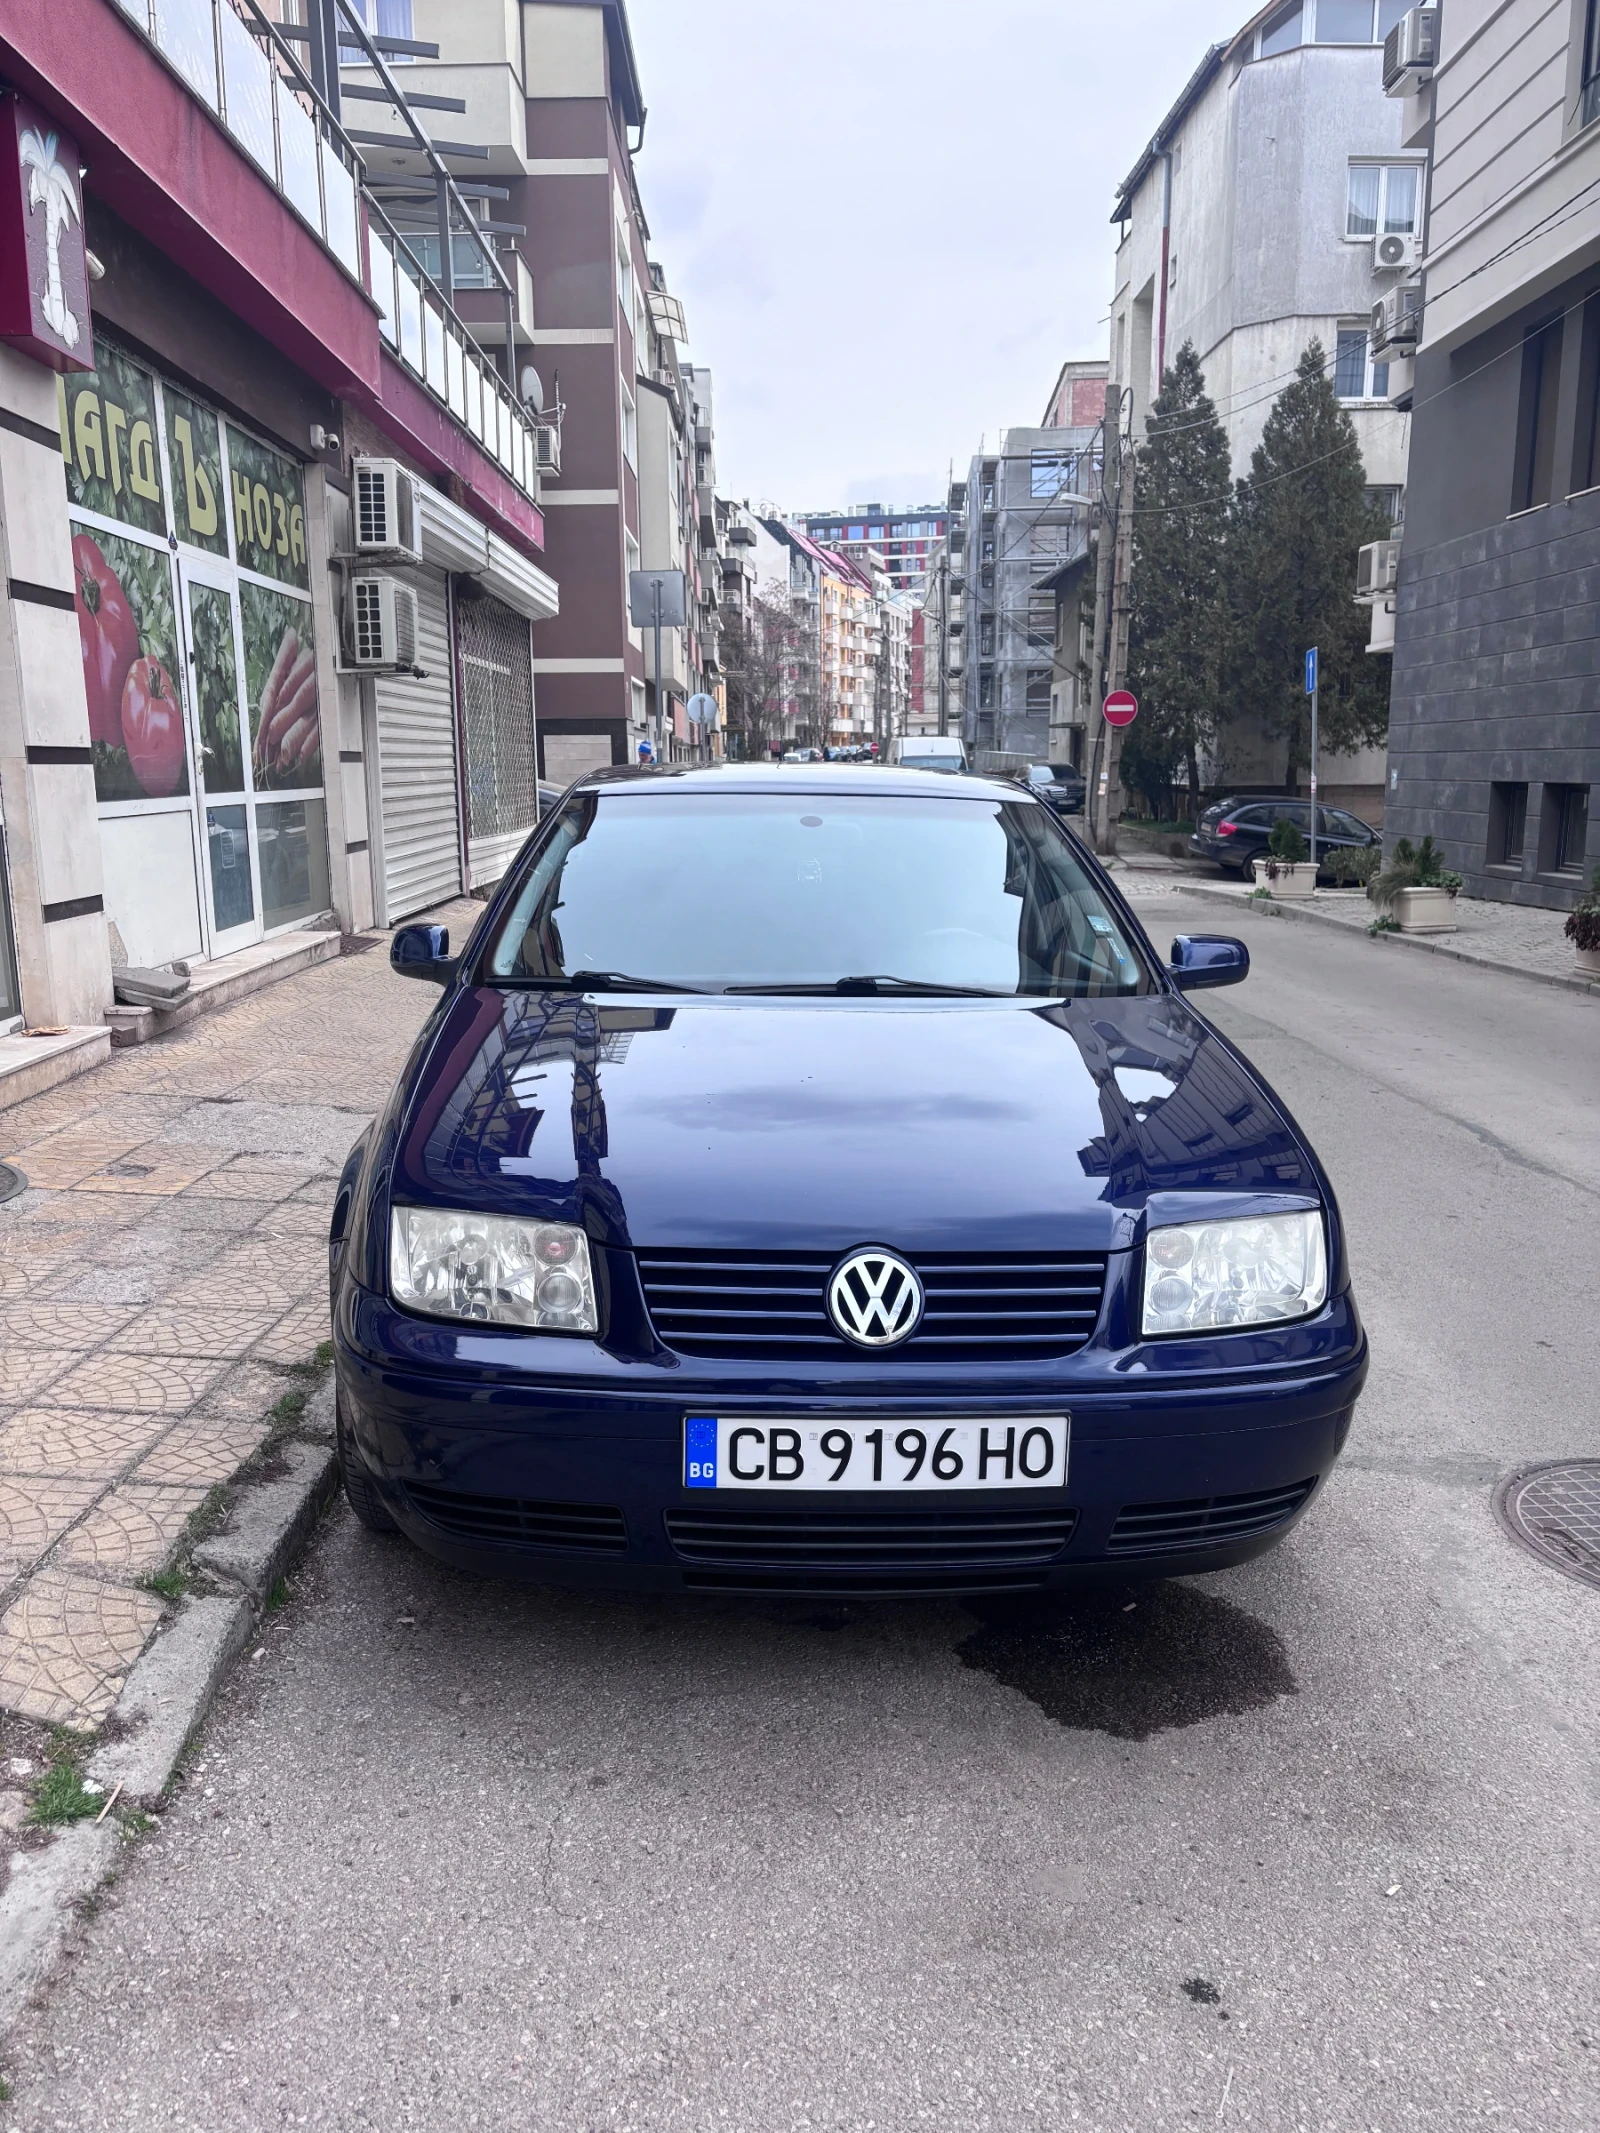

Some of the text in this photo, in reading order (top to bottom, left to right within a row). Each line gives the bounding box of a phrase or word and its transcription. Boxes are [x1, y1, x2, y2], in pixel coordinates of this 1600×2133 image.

[55, 372, 306, 567] АГДЪНОЗА
[831, 1253, 920, 1345] VW
[689, 1462, 715, 1478] BG
[820, 1428, 964, 1481] 9196
